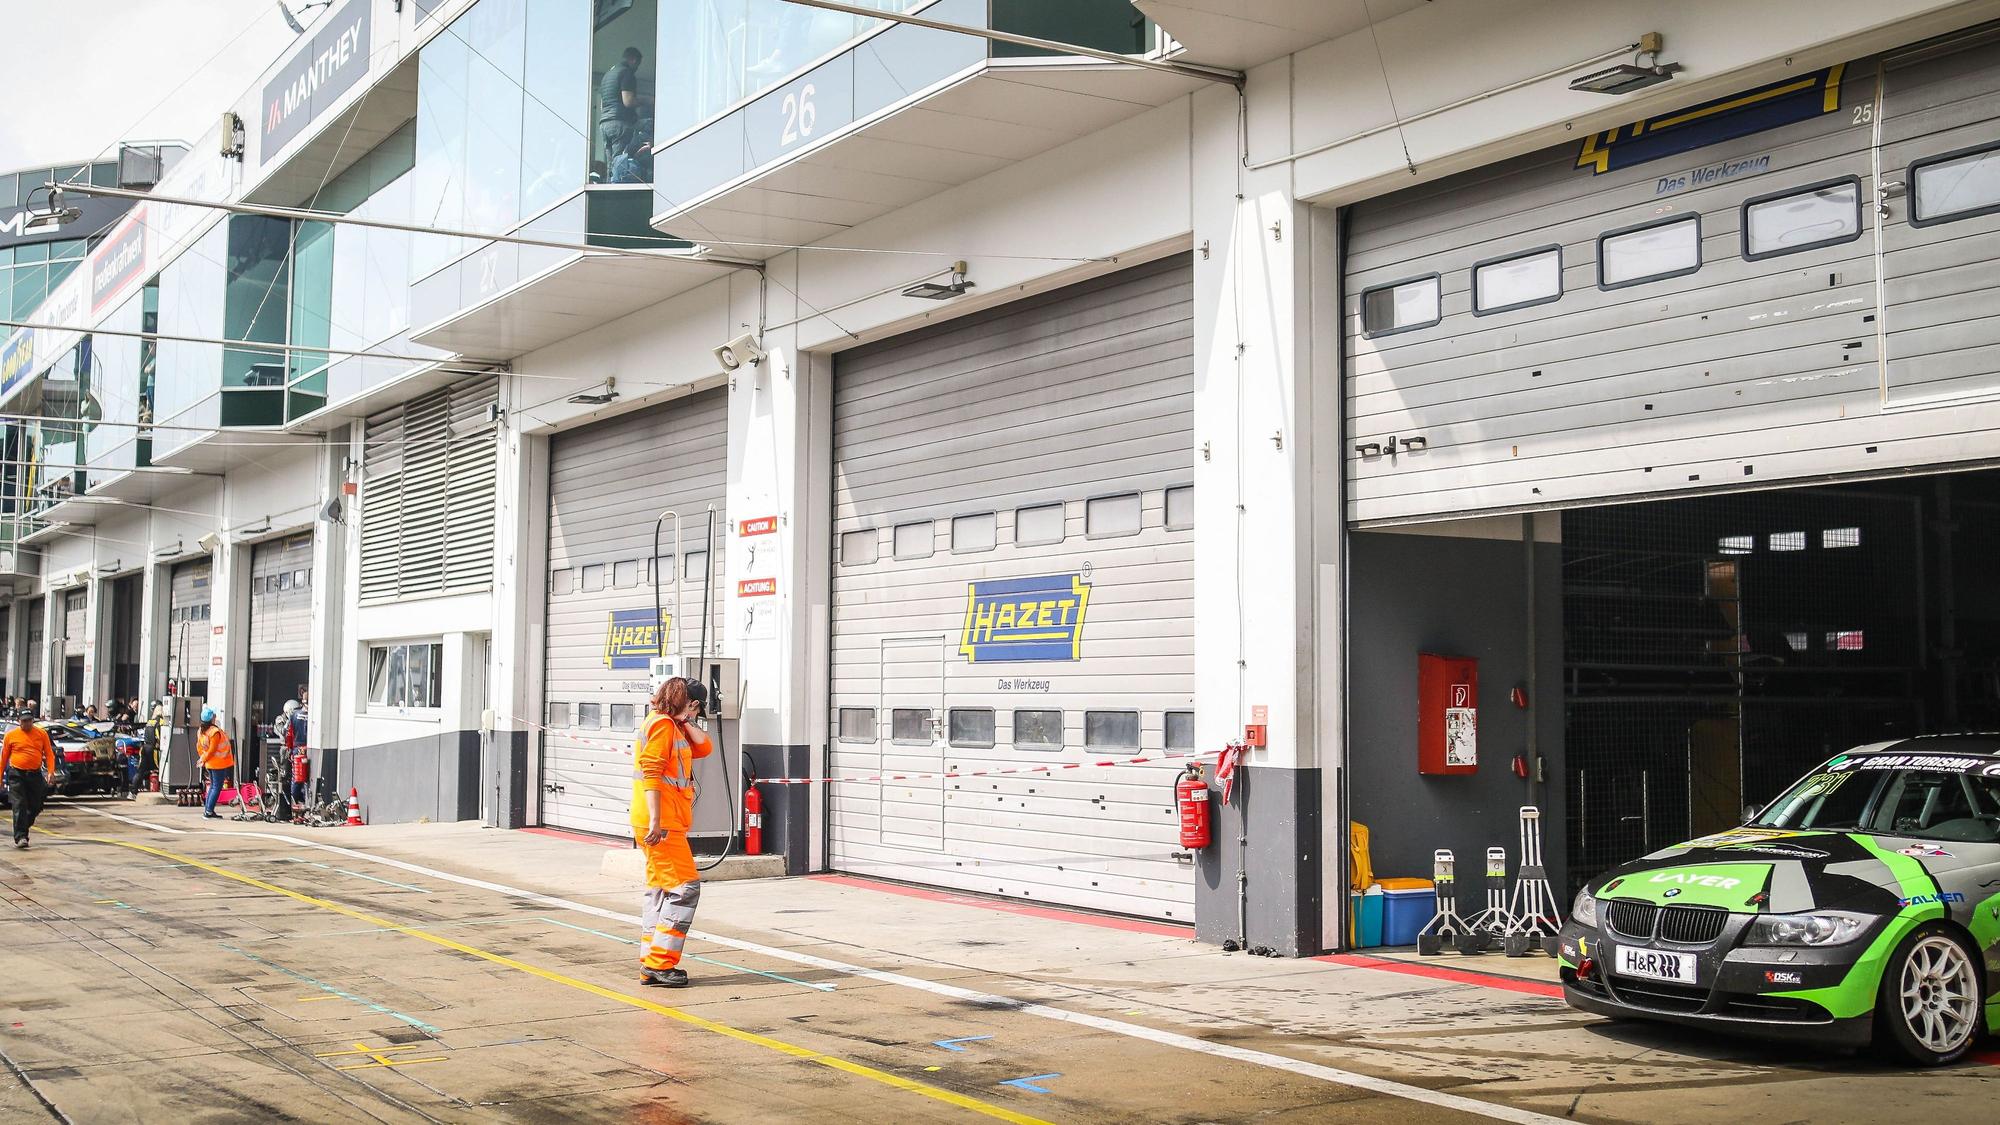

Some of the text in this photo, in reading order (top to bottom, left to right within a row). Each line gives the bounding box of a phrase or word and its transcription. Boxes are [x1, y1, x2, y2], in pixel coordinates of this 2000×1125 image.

[283, 17, 362, 119] MANTHEY
[781, 83, 816, 146] 26
[1852, 103, 1872, 125] 25
[1656, 154, 1771, 195] Das Werkzeug
[746, 521, 769, 532] CAUTION
[743, 582, 770, 593] ACHTUNG
[972, 599, 1076, 643] HAZET
[998, 678, 1050, 692] Das Werkzeug
[1863, 756, 1909, 767] GRAN
[1648, 872, 1741, 889] LAYER
[1897, 892, 1965, 909] FALKEN
[1627, 951, 1657, 973] H&R
